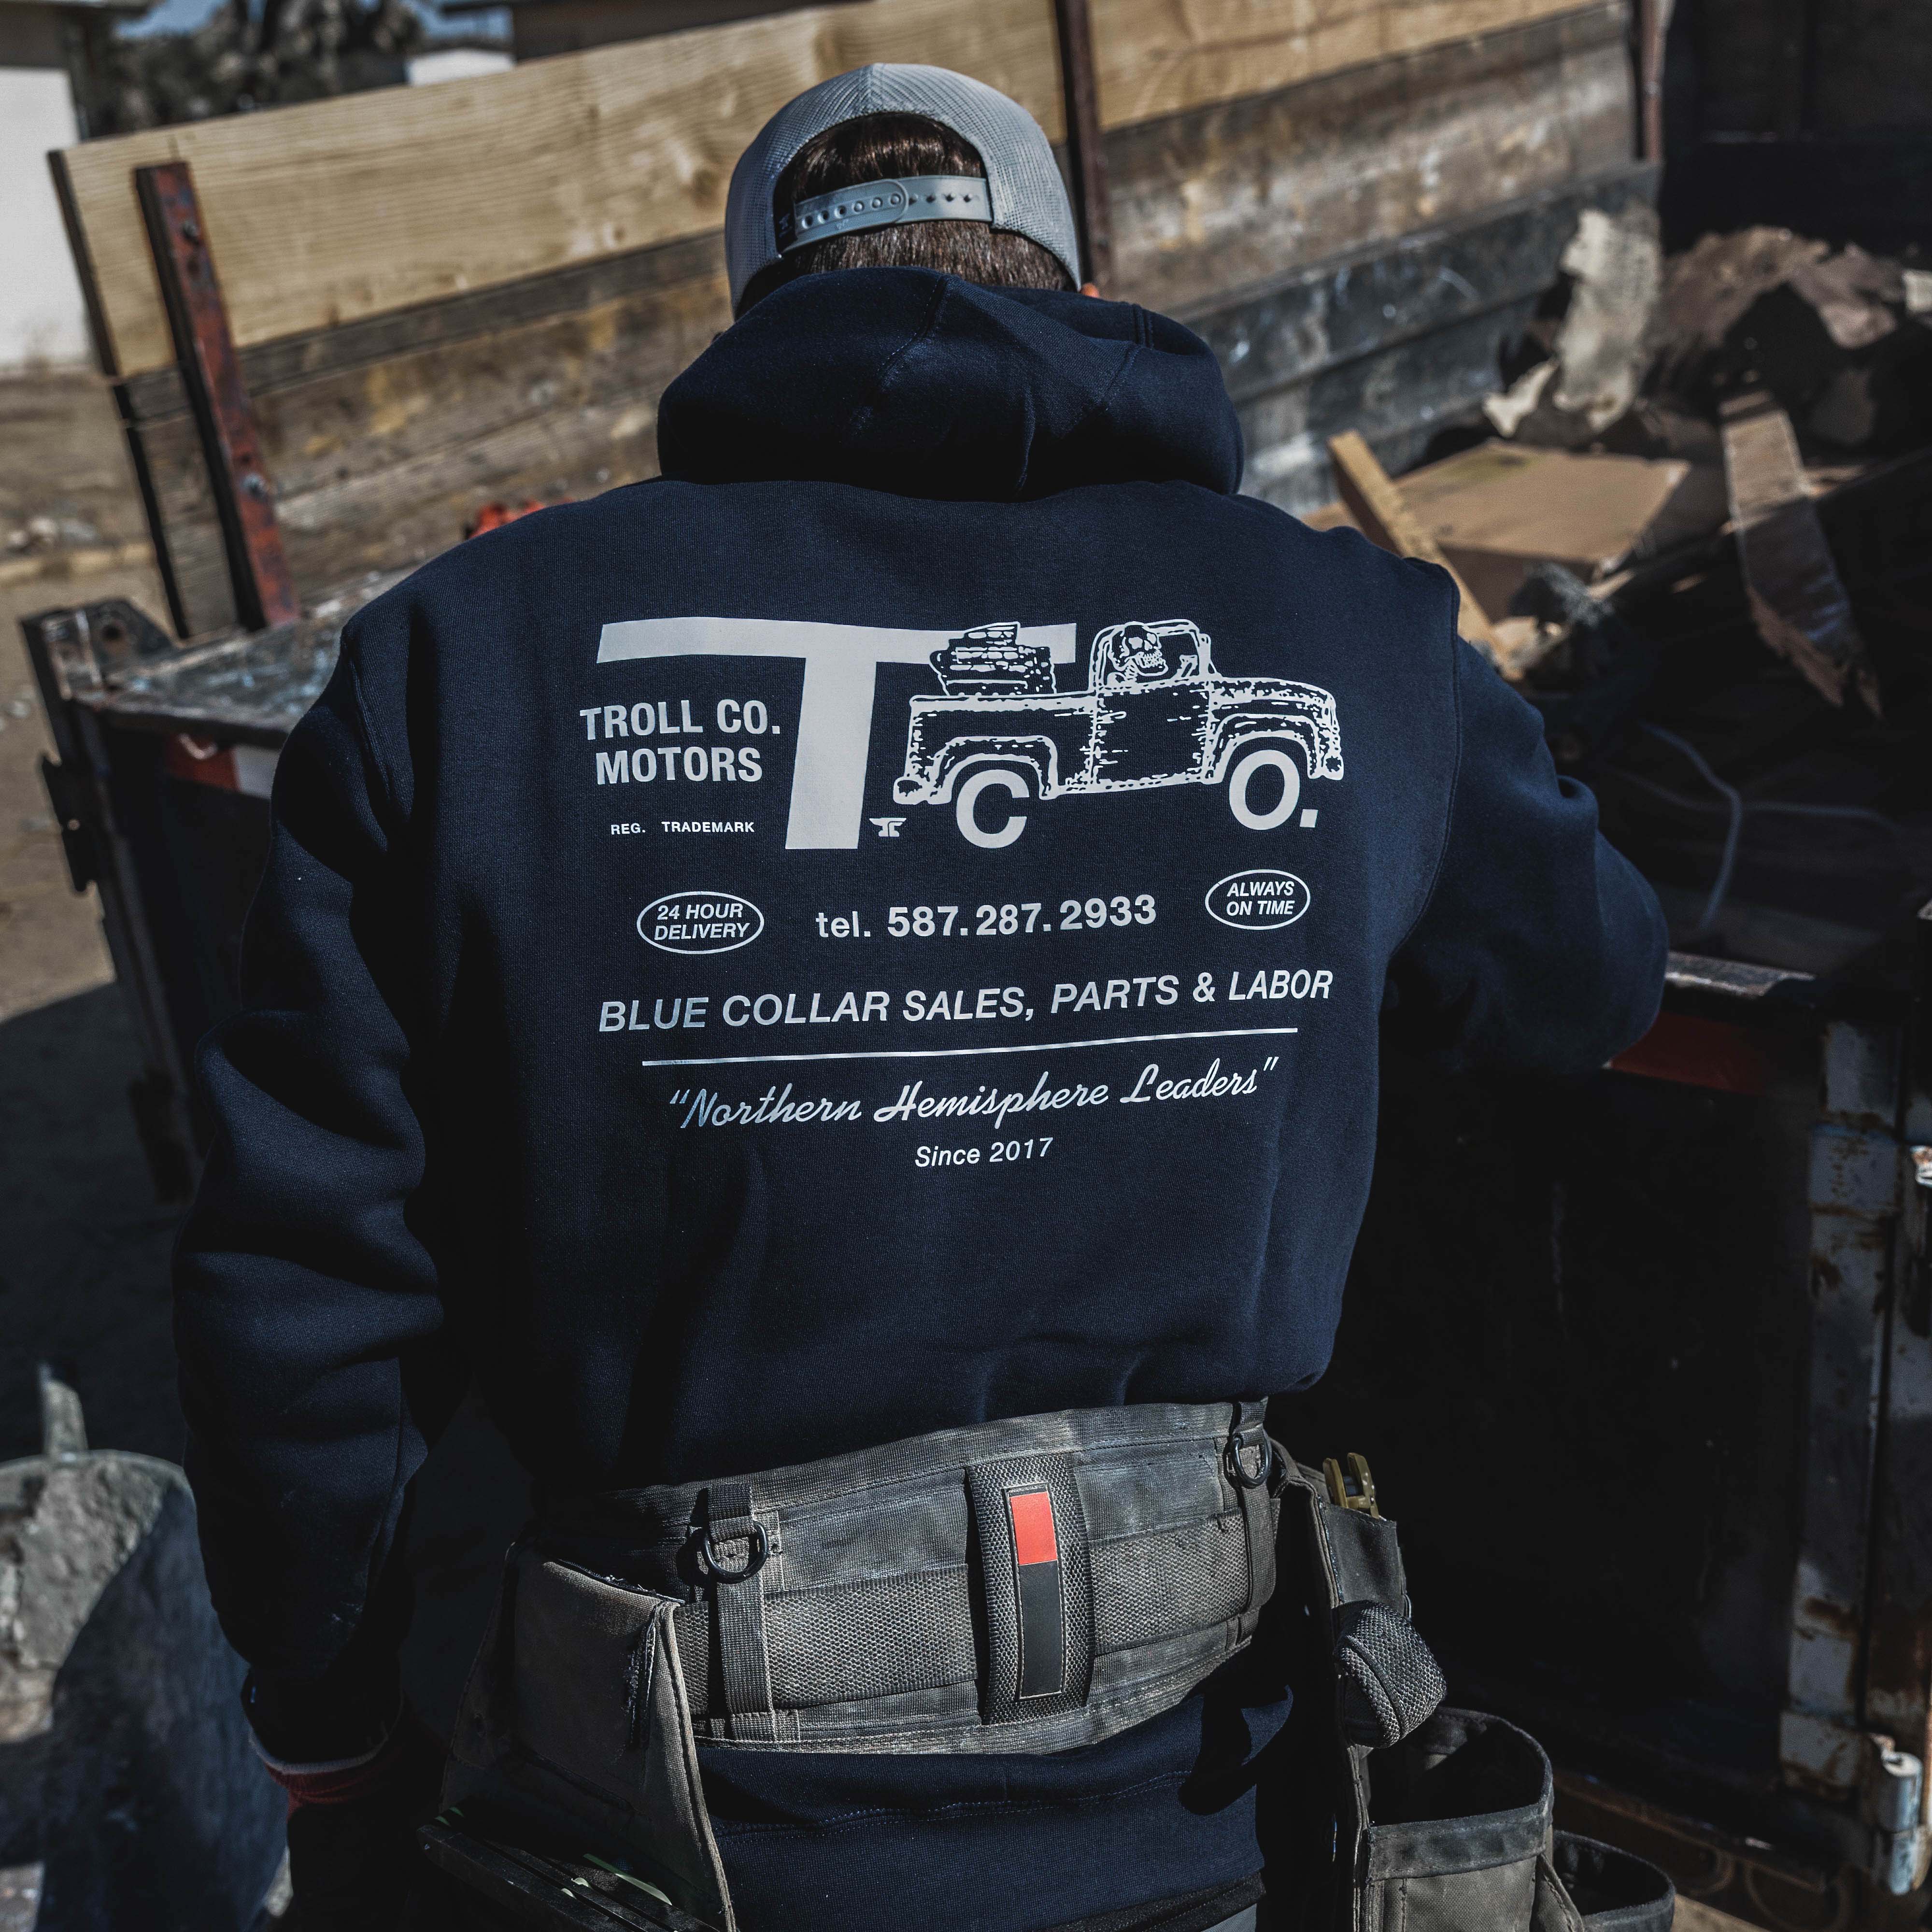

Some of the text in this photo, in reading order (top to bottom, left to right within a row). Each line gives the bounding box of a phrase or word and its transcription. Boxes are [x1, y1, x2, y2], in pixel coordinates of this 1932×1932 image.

[580, 699, 781, 740] TROLL CO.
[597, 617, 1076, 850] T
[596, 746, 762, 785] MOTORS
[611, 822, 755, 835] REG. TRADEMARK
[1227, 881, 1295, 897] ALWAYS
[657, 903, 743, 920] 24 HOUR
[1226, 900, 1295, 916] ON TIME
[654, 923, 750, 940] DELIVERY
[816, 911, 871, 938] tel.
[599, 969, 1334, 1032] BLUE COLLAR SALES, PARTS & LABOR
[669, 1056, 1280, 1129] “Northern Hemisphere Leaders”
[915, 1137, 1053, 1167] Since 2017
